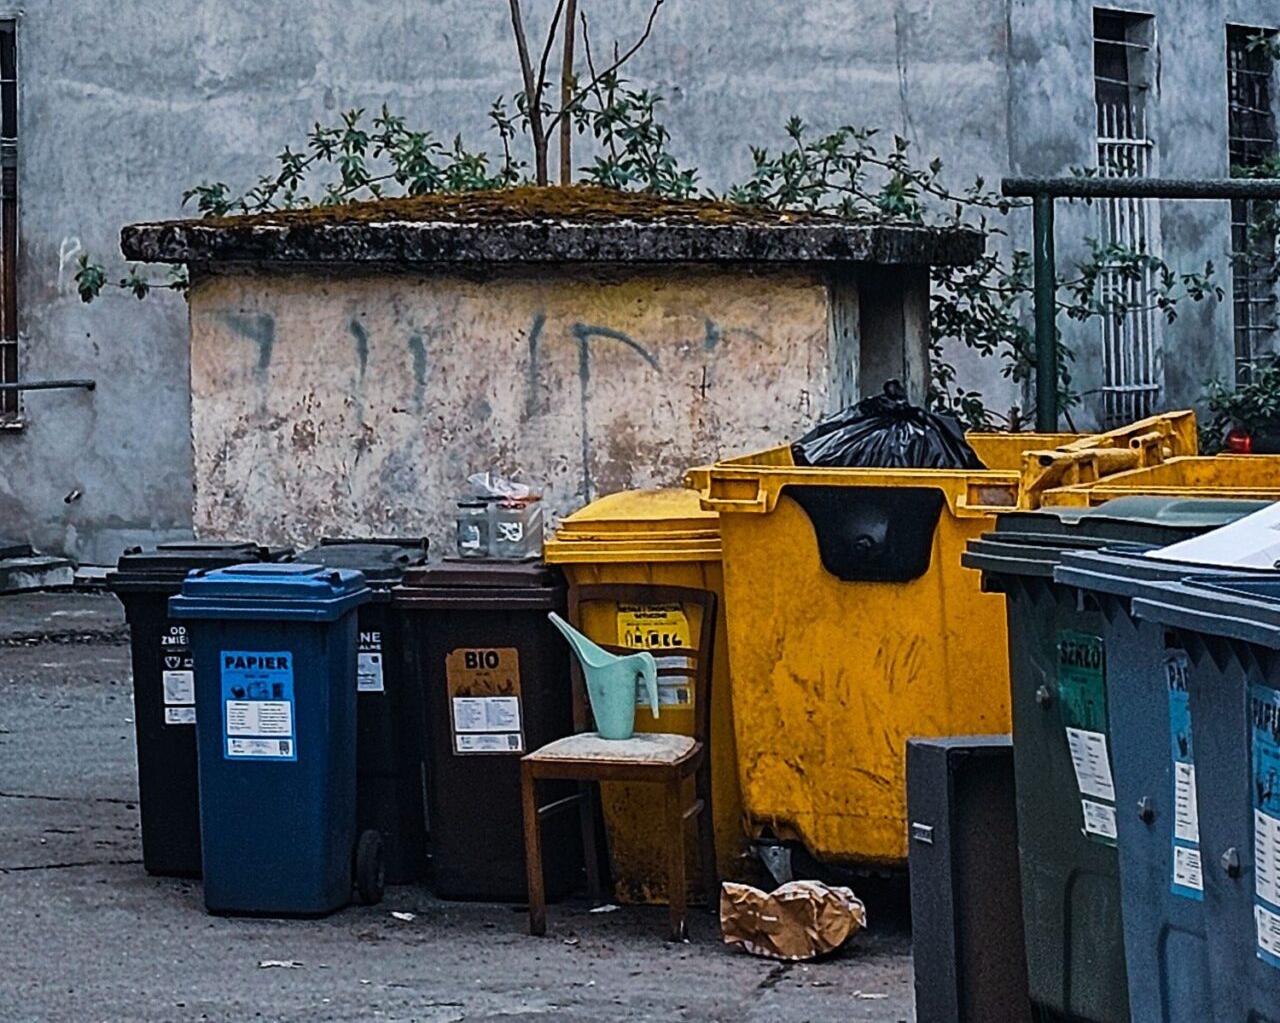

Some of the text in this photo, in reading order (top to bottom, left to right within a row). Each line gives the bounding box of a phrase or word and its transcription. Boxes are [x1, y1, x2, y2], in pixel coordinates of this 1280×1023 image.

[161, 635, 189, 645] ZMIE
[358, 632, 381, 643] NE
[224, 656, 288, 670] PAPIER
[464, 651, 499, 669] BIO
